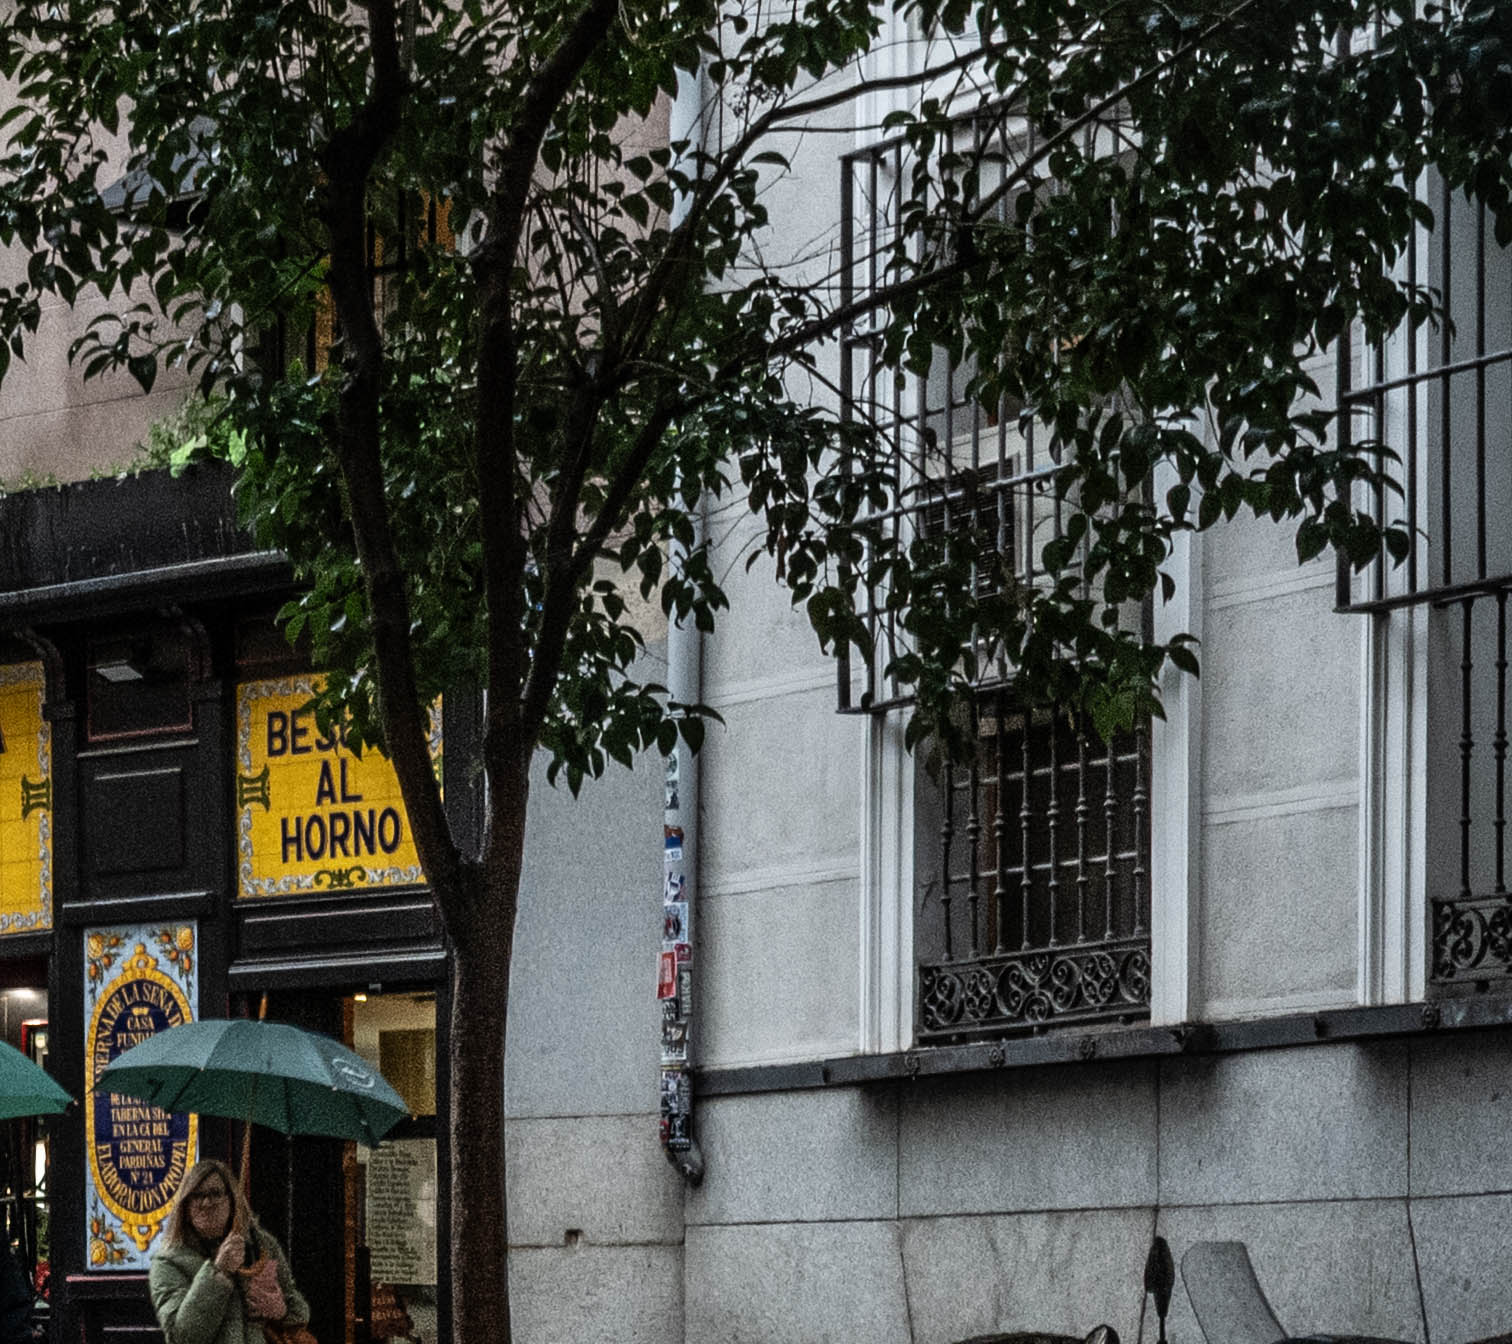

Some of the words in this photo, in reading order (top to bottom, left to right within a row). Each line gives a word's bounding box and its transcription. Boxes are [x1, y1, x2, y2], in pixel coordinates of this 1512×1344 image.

[316, 758, 363, 807] AL
[281, 807, 401, 864] HORNO
[107, 994, 126, 1020] DE
[122, 983, 140, 1006] LA
[127, 1015, 155, 1031] CASA
[111, 1108, 151, 1122] TABERNA
[120, 1139, 163, 1153] GENERAL
